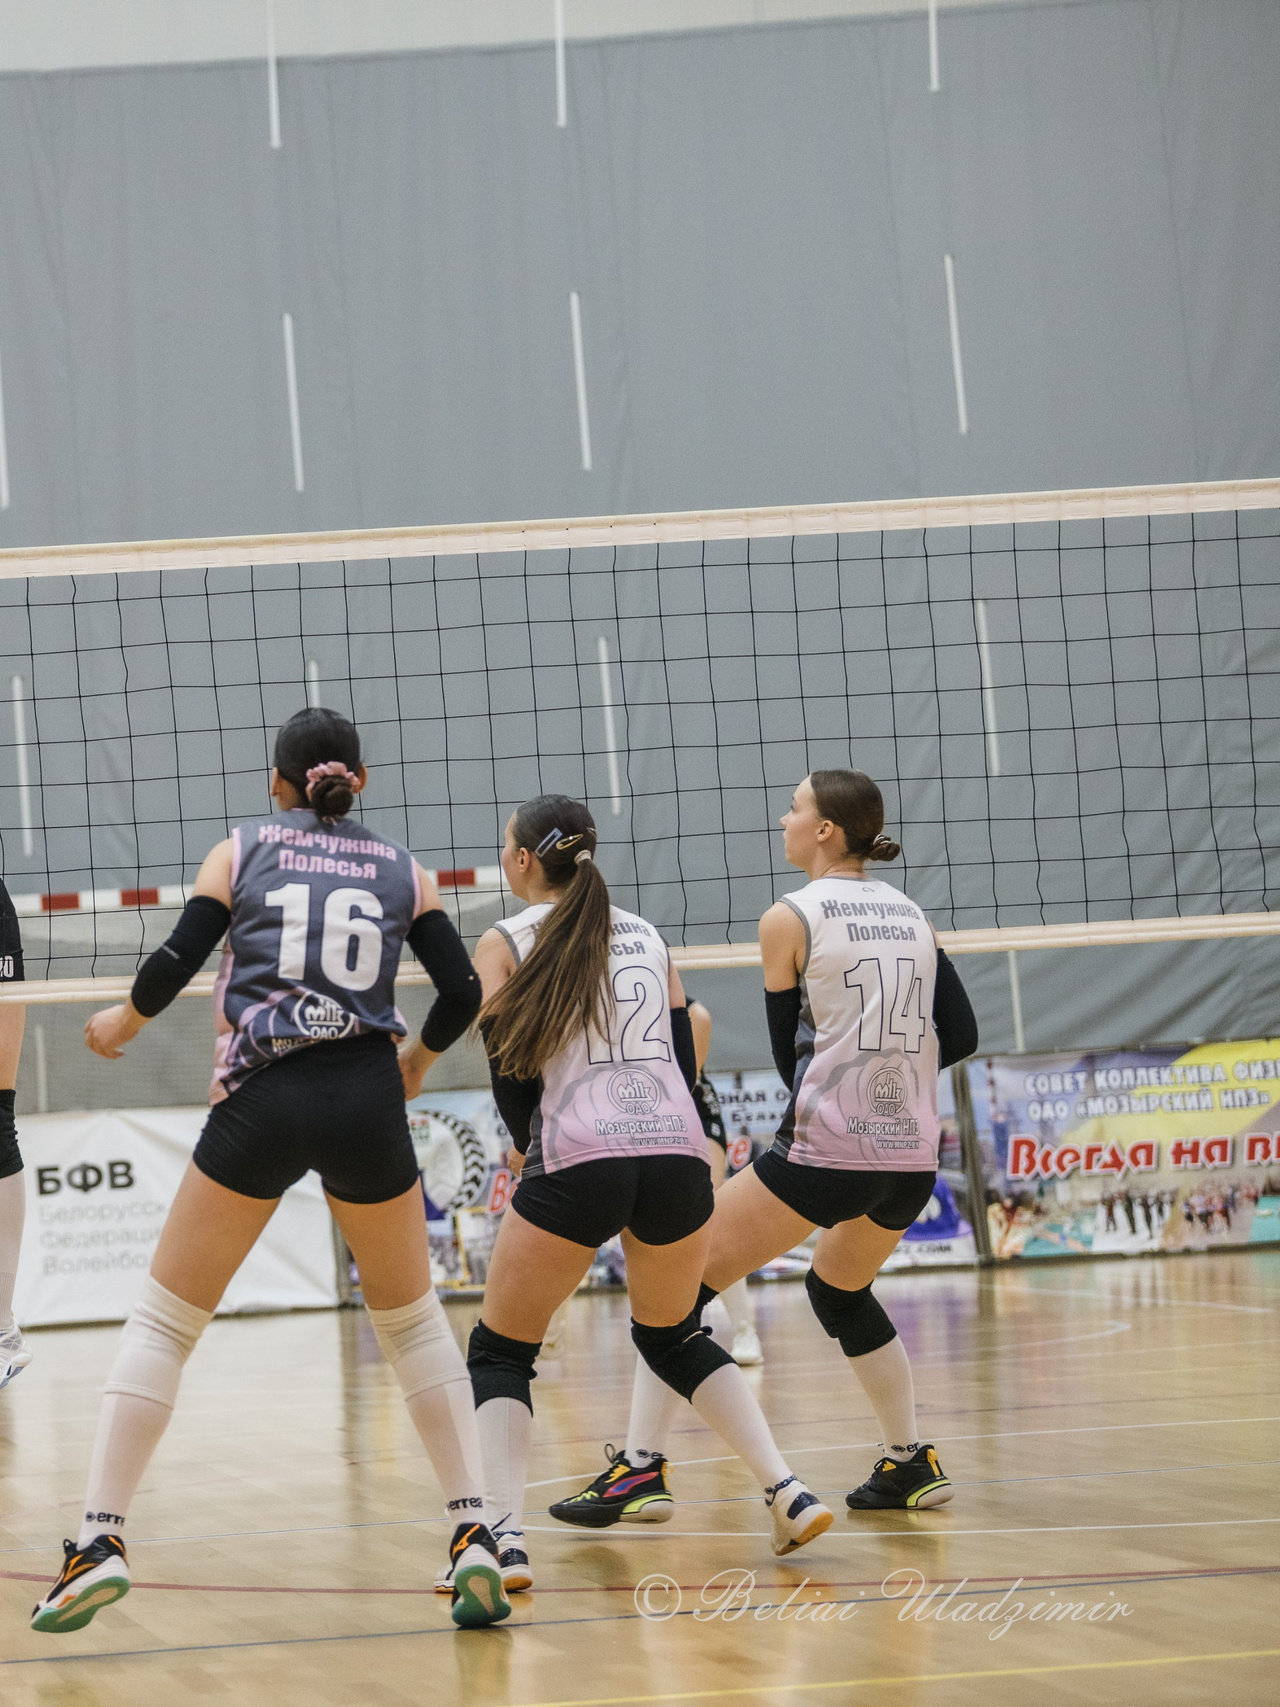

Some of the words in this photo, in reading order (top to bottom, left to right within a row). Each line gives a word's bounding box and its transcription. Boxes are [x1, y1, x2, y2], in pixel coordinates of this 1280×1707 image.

[258, 824, 397, 861] Жемчужина
[279, 849, 377, 879] Полесья
[820, 899, 921, 920] Жемчужина
[265, 882, 384, 992] 16
[846, 922, 917, 942] Полесья
[843, 957, 926, 1054] 14
[310, 1026, 338, 1040] ОАО
[1025, 1071, 1087, 1096] СОВЕТ
[1094, 1064, 1227, 1091] КОЛЛЕКТИВА
[1233, 1059, 1280, 1082] ФИЗ
[626, 1102, 651, 1115] ОАО
[876, 1103, 896, 1117] ОАО
[1028, 1100, 1068, 1122] ОАО
[595, 1115, 663, 1138] Мозырский
[662, 1115, 687, 1132] НПЗ
[847, 1116, 901, 1138] Мозырский
[902, 1117, 920, 1136] НПЗ
[1009, 1134, 1157, 1178] Всегда
[1171, 1135, 1232, 1168] на
[36, 1160, 134, 1195] БФВ
